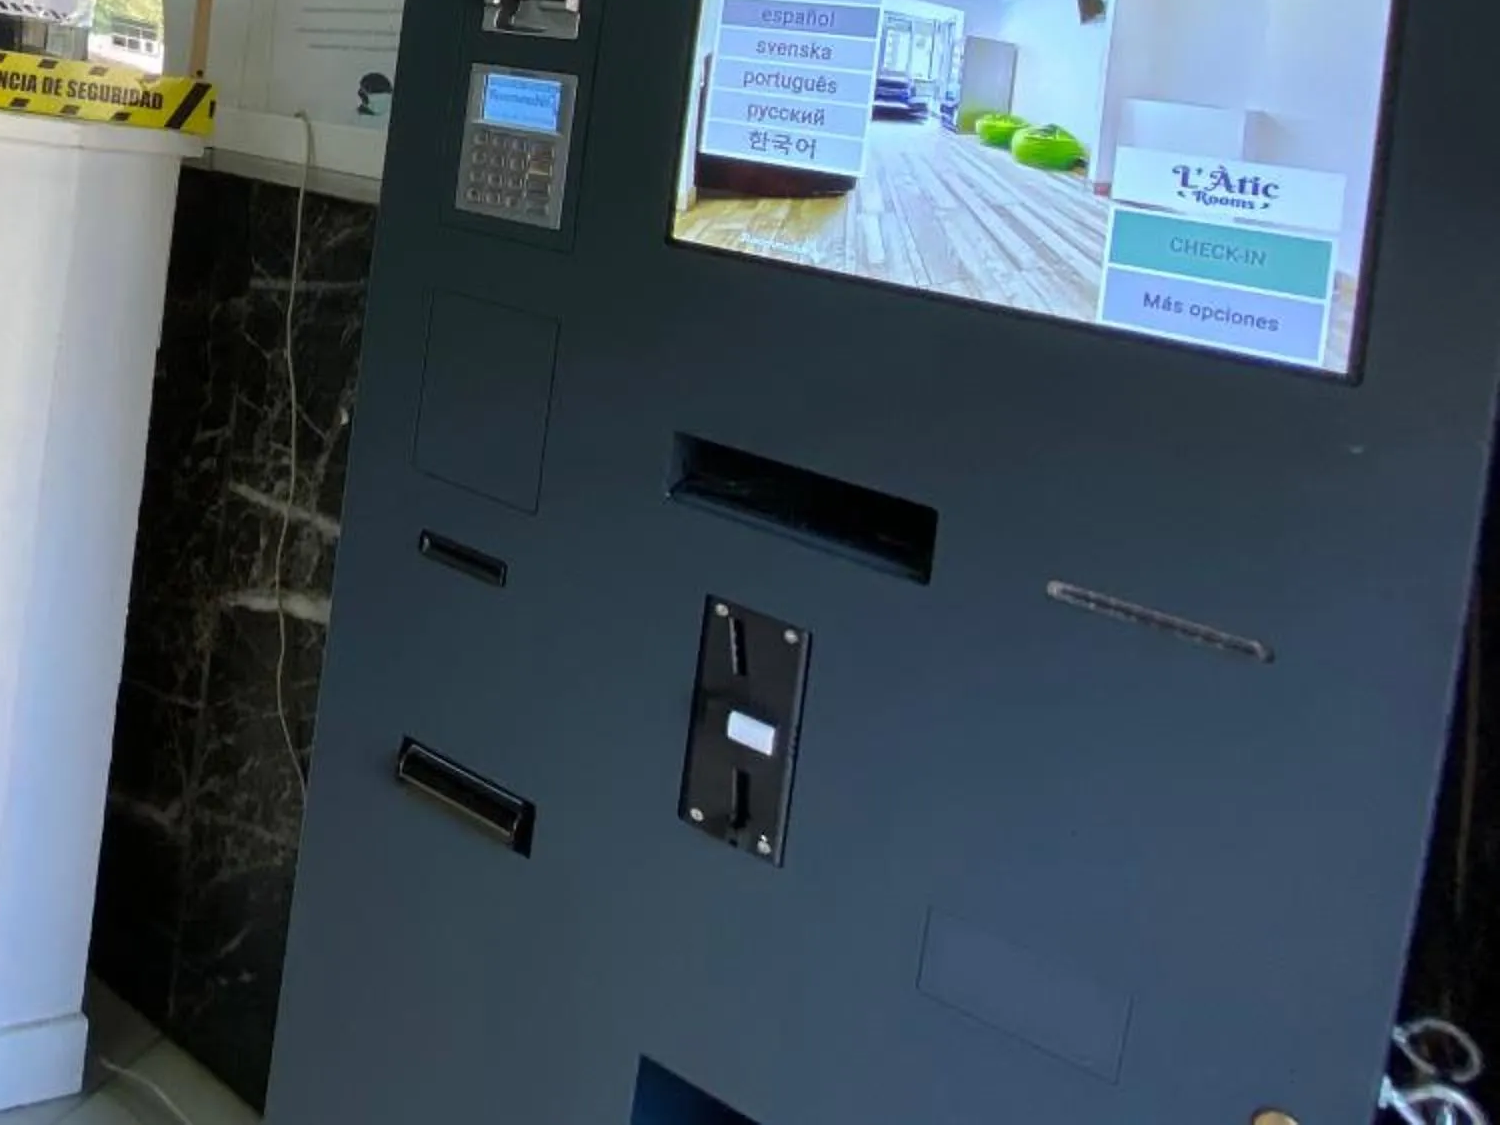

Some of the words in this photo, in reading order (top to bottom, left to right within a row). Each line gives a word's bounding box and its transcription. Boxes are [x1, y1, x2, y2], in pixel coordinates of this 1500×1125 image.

[761, 8, 835, 28] español
[755, 39, 833, 61] svenska
[41, 77, 64, 97] DE
[66, 81, 164, 110] SEGURIDAD
[743, 70, 838, 95] português
[747, 103, 825, 126] русский
[749, 129, 818, 160] 한국어
[1192, 190, 1256, 211] Rooms
[1169, 236, 1267, 267] CHECK-IN
[1143, 291, 1184, 314] Más
[1189, 303, 1280, 332] opciones
